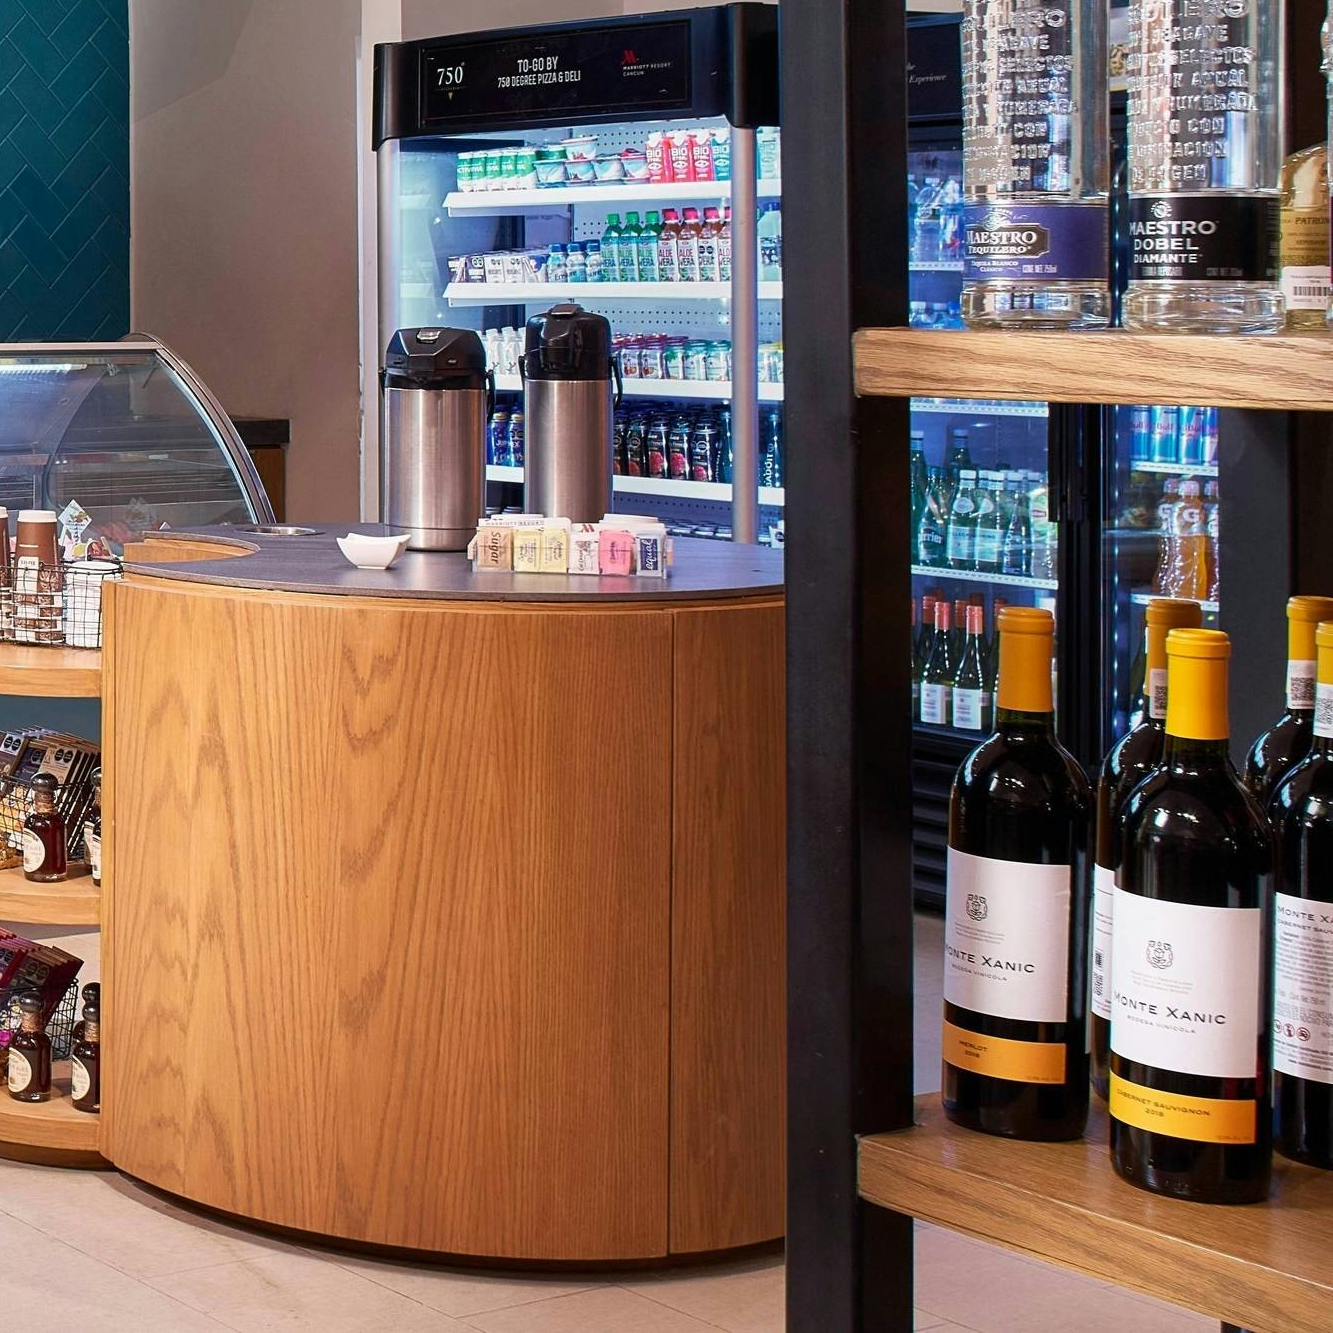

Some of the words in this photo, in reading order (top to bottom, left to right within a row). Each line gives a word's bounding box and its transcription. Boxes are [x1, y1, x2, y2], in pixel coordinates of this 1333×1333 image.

[517, 58, 545, 73] TO-GO
[546, 56, 559, 70] BY
[497, 77, 510, 89] 750
[511, 74, 537, 88] DEGREE
[537, 72, 557, 85] PIZZA
[558, 72, 564, 83] &
[564, 70, 581, 82] DELI
[1129, 220, 1216, 236] MAESTRO
[965, 230, 1037, 246] MAESTRO
[1134, 238, 1199, 251] DOBEL
[968, 245, 1029, 255] TEQUILERO
[1134, 253, 1198, 264] DIAMANTE
[488, 531, 501, 564] Sugar
[645, 538, 654, 571] equal
[1277, 906, 1315, 922] MONTE
[946, 944, 976, 964] ONTE
[981, 955, 1035, 974] XANIC
[1113, 990, 1158, 1015] MONTE
[1166, 1006, 1227, 1025] XANIC
[959, 1040, 988, 1053] MERLOT
[1116, 1087, 1152, 1105] CABERNET
[1153, 1102, 1211, 1117] SAUVIGNON
